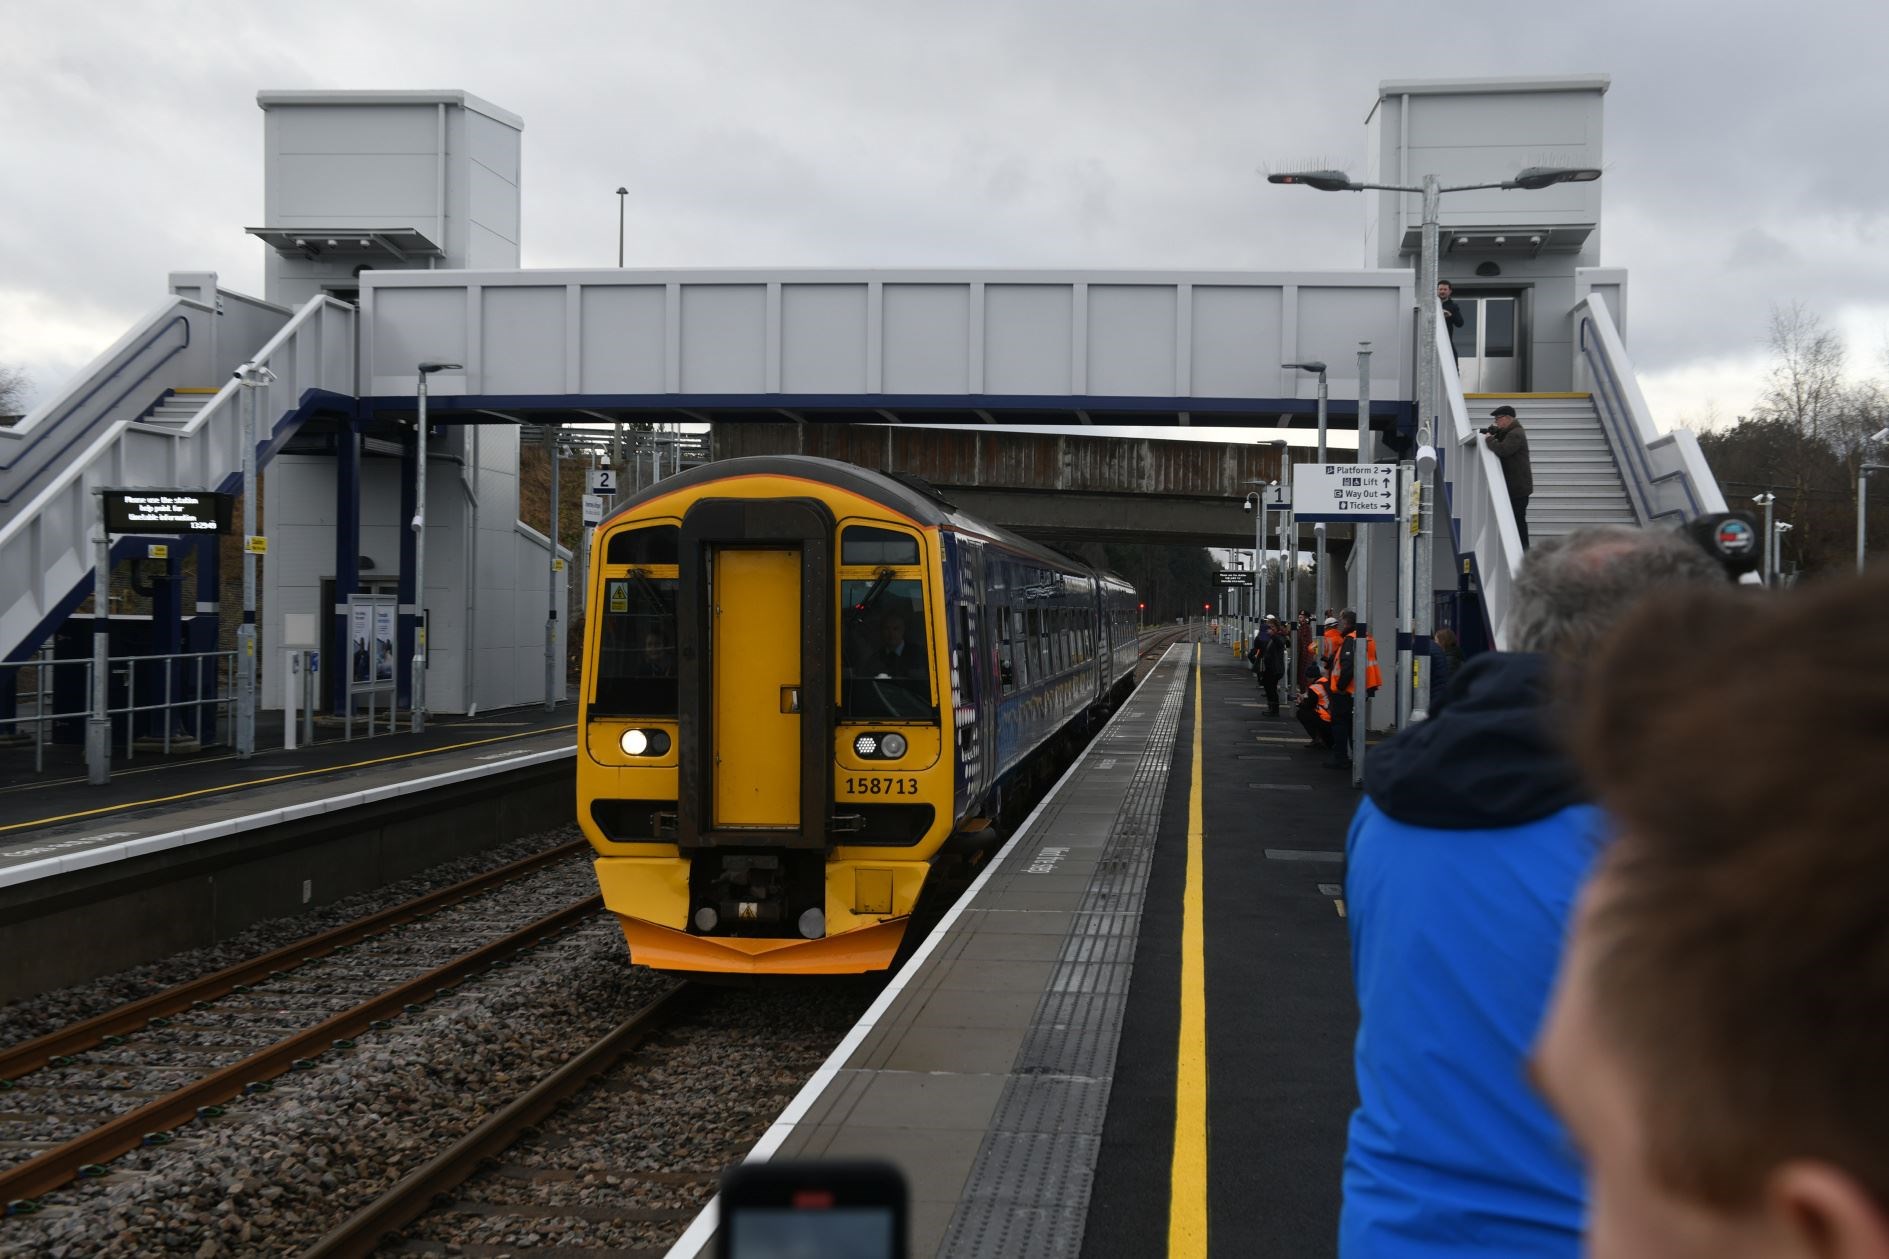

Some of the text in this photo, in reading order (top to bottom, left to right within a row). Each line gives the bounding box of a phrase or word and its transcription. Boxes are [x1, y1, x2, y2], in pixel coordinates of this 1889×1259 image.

[1336, 466, 1379, 474] Platform 2
[600, 472, 609, 487] 2
[1363, 478, 1378, 486] Lift
[1274, 487, 1283, 502] 1
[1345, 490, 1378, 499] Way Out
[1349, 502, 1378, 510] Tickets
[845, 778, 918, 794] 158713
